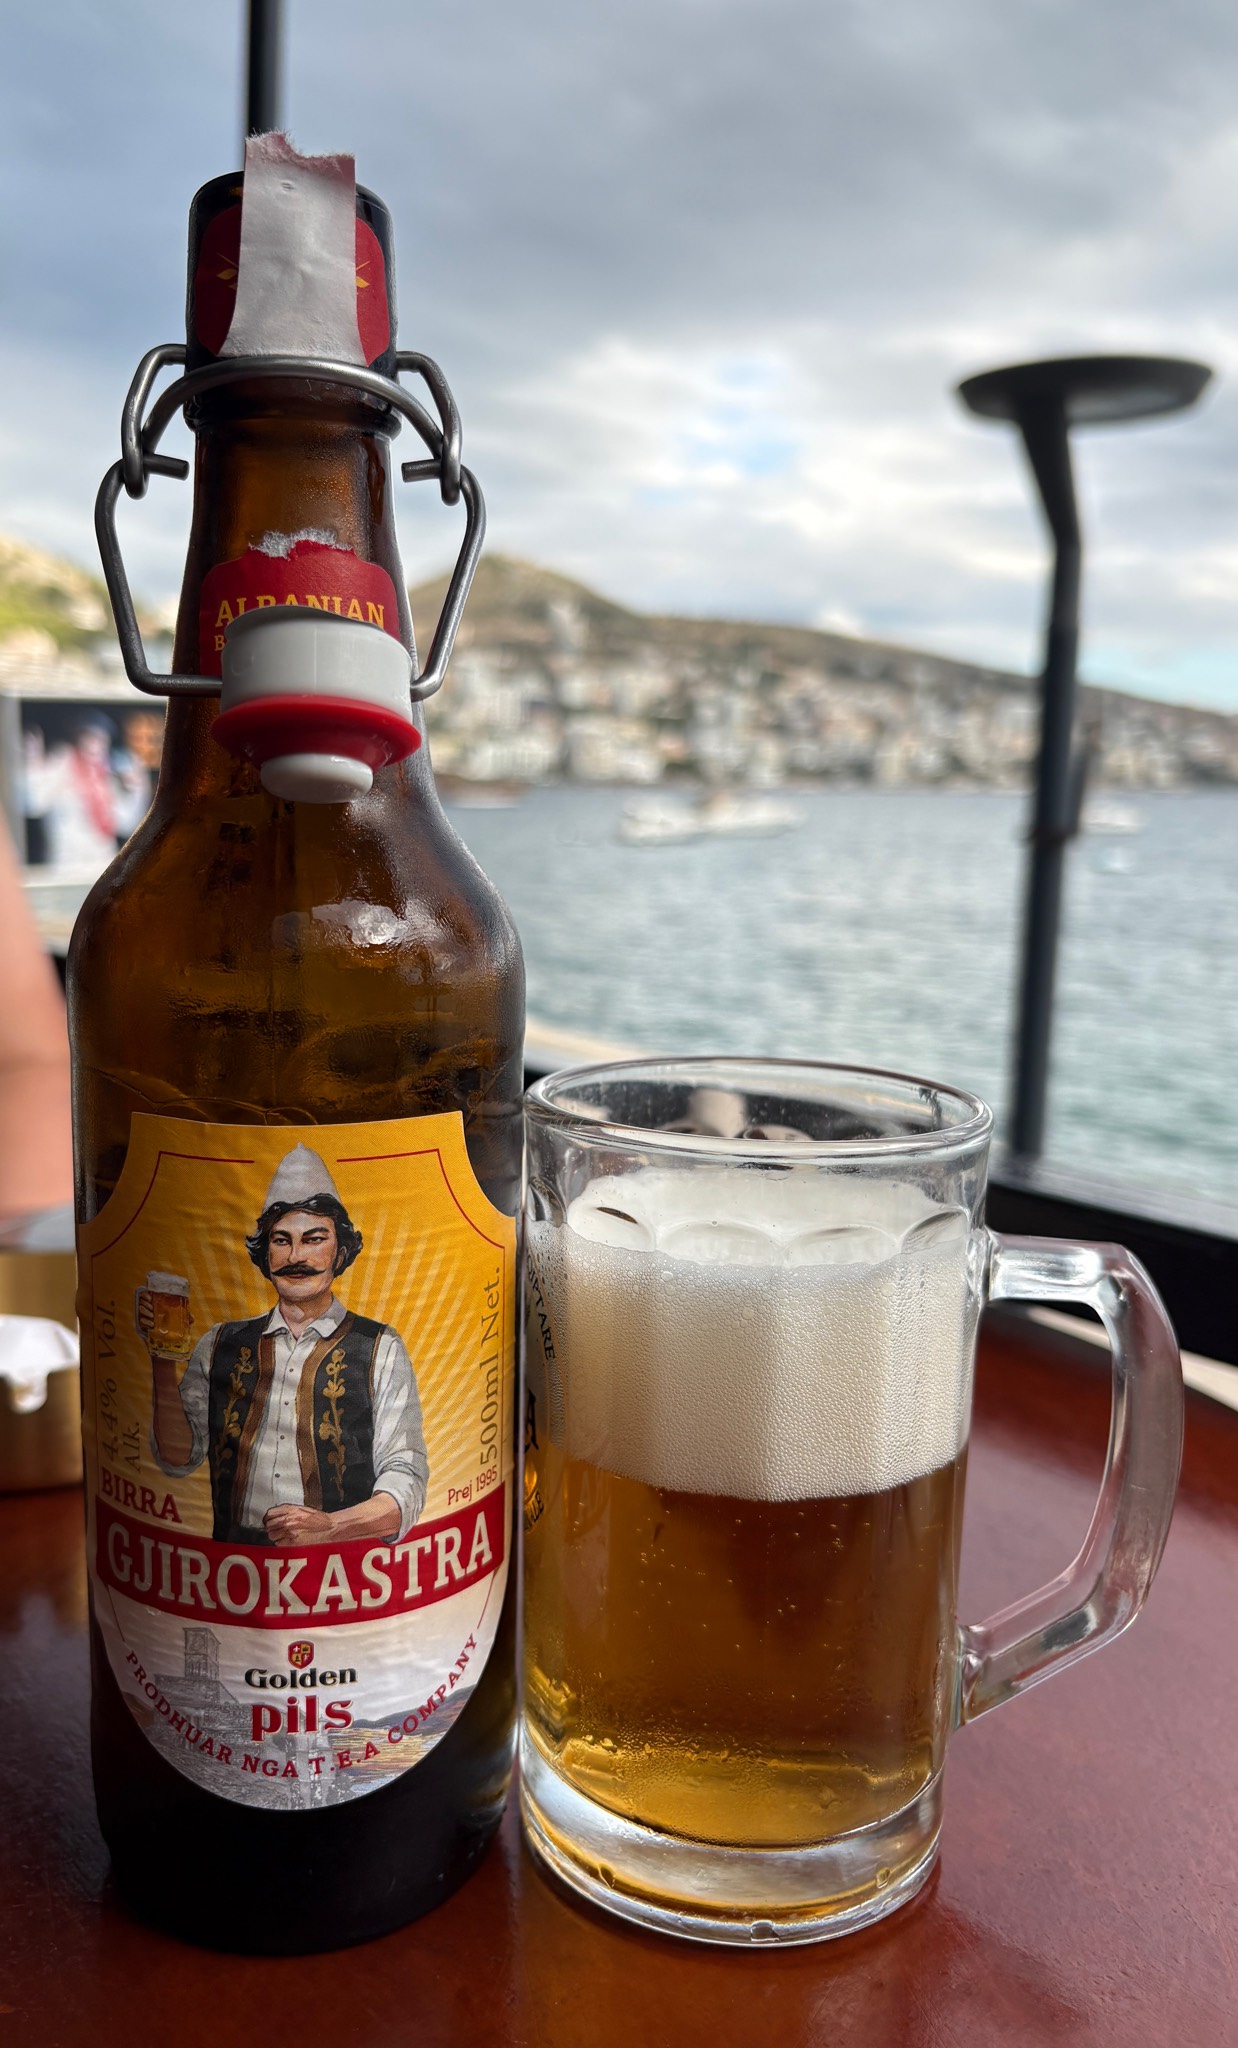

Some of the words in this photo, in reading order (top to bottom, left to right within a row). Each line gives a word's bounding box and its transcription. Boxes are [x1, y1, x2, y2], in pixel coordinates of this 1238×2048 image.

[96, 1300, 116, 1359] Vol.
[481, 1266, 500, 1348] Net.
[98, 1377, 118, 1462] 4.4%
[480, 1353, 499, 1465] 500ml
[122, 1422, 140, 1473] Alk.
[101, 1467, 182, 1524] BIRRA
[447, 1487, 473, 1505] Prej
[476, 1466, 498, 1491] 1995
[107, 1511, 494, 1617] GJIROKASTRA
[126, 1651, 233, 1765] PRODHUAR
[241, 1754, 299, 1778] NGA
[387, 1633, 478, 1744] COMPANY
[244, 1668, 358, 1690] Golden
[251, 1695, 353, 1742] pils
